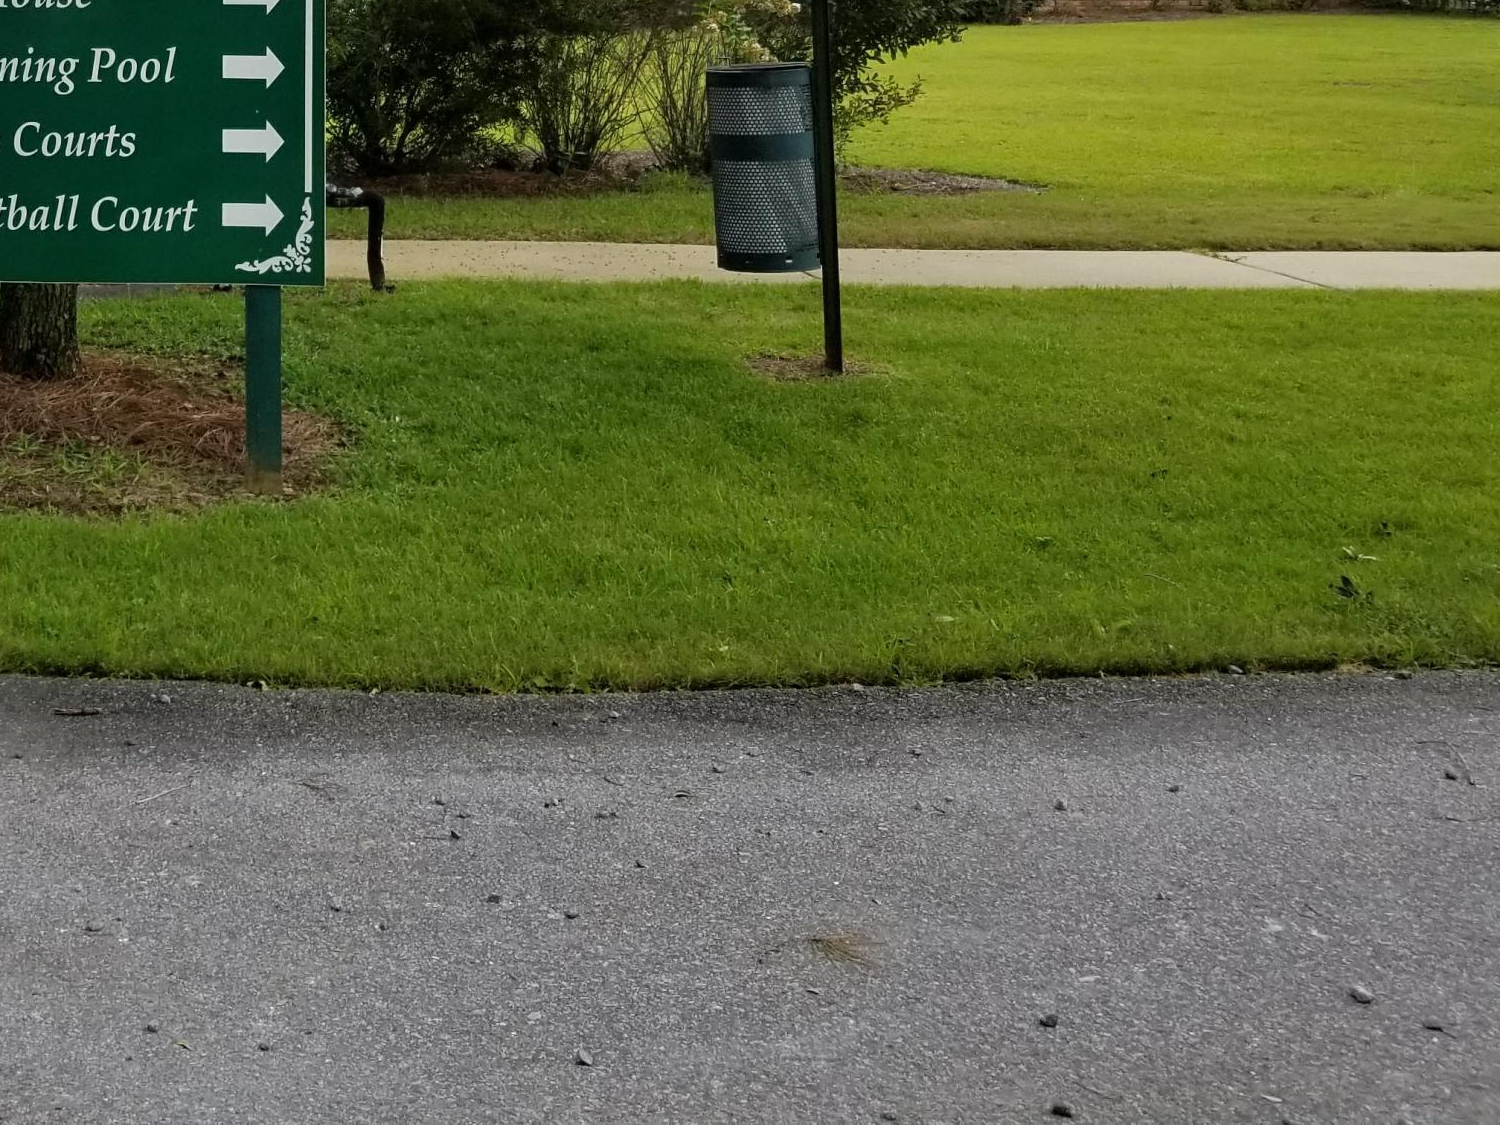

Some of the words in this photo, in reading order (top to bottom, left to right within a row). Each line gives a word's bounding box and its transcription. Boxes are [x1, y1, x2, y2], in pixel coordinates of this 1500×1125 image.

[88, 47, 177, 83] Pool
[14, 121, 136, 157] Courts
[91, 196, 197, 232] Court
